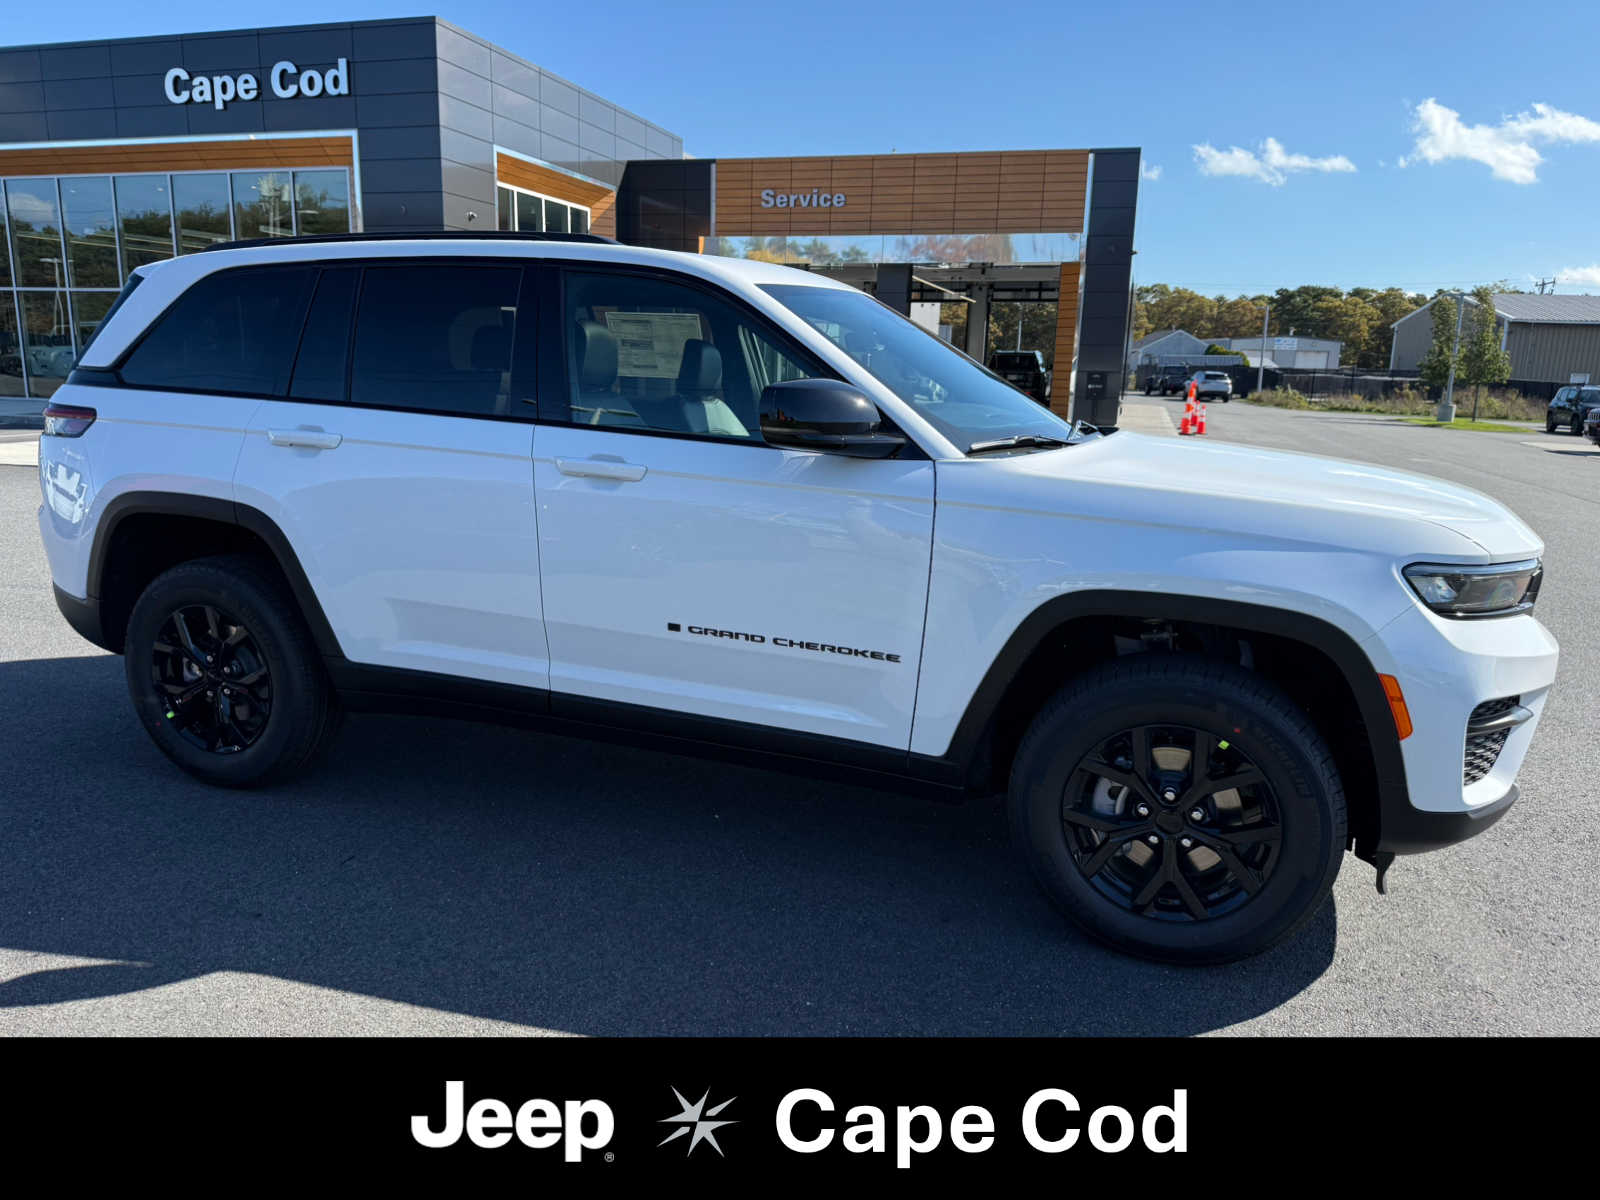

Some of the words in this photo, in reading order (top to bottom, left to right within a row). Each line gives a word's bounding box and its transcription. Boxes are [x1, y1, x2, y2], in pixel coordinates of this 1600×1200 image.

[164, 67, 258, 110] Cape
[270, 57, 349, 99] Cod
[760, 188, 846, 208] Service
[687, 625, 766, 643] GRAND
[772, 637, 901, 663] CHEROKEE
